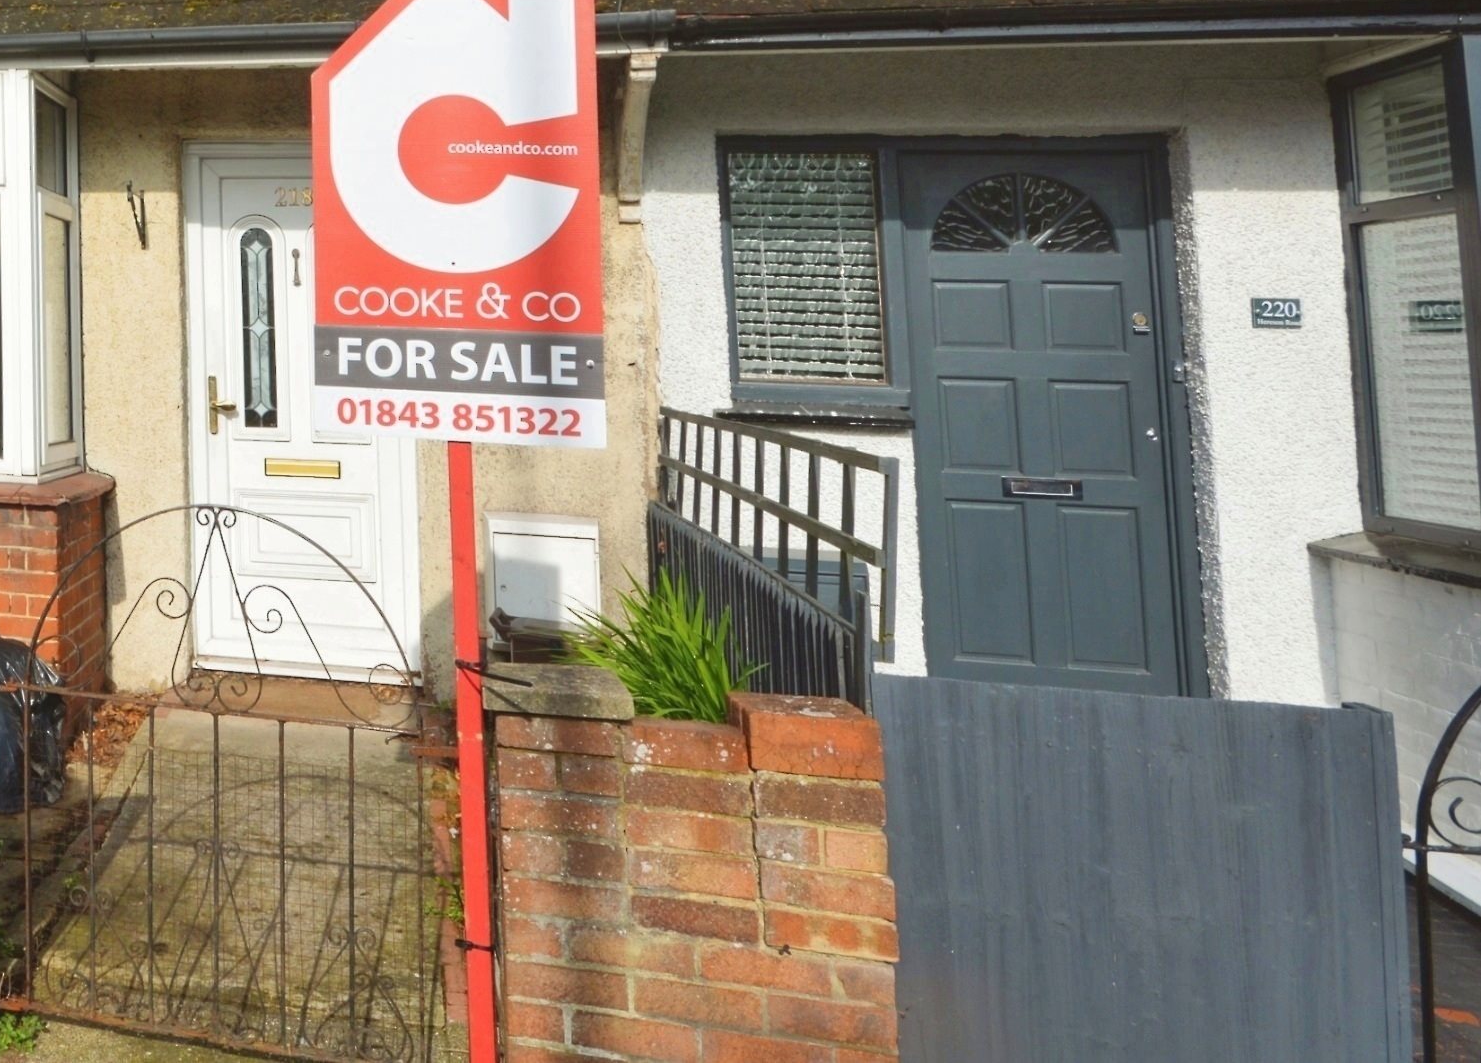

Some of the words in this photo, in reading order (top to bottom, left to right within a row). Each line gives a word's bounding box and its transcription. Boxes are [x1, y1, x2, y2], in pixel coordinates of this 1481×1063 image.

[447, 140, 578, 156] cookeandco.com
[274, 187, 314, 207] 218
[334, 286, 464, 318] COOKE
[476, 282, 511, 320] &
[521, 291, 581, 323] CO
[338, 337, 437, 379] FOR
[450, 341, 579, 386] SALE
[336, 397, 440, 430] 01843
[451, 402, 582, 437] 851322
